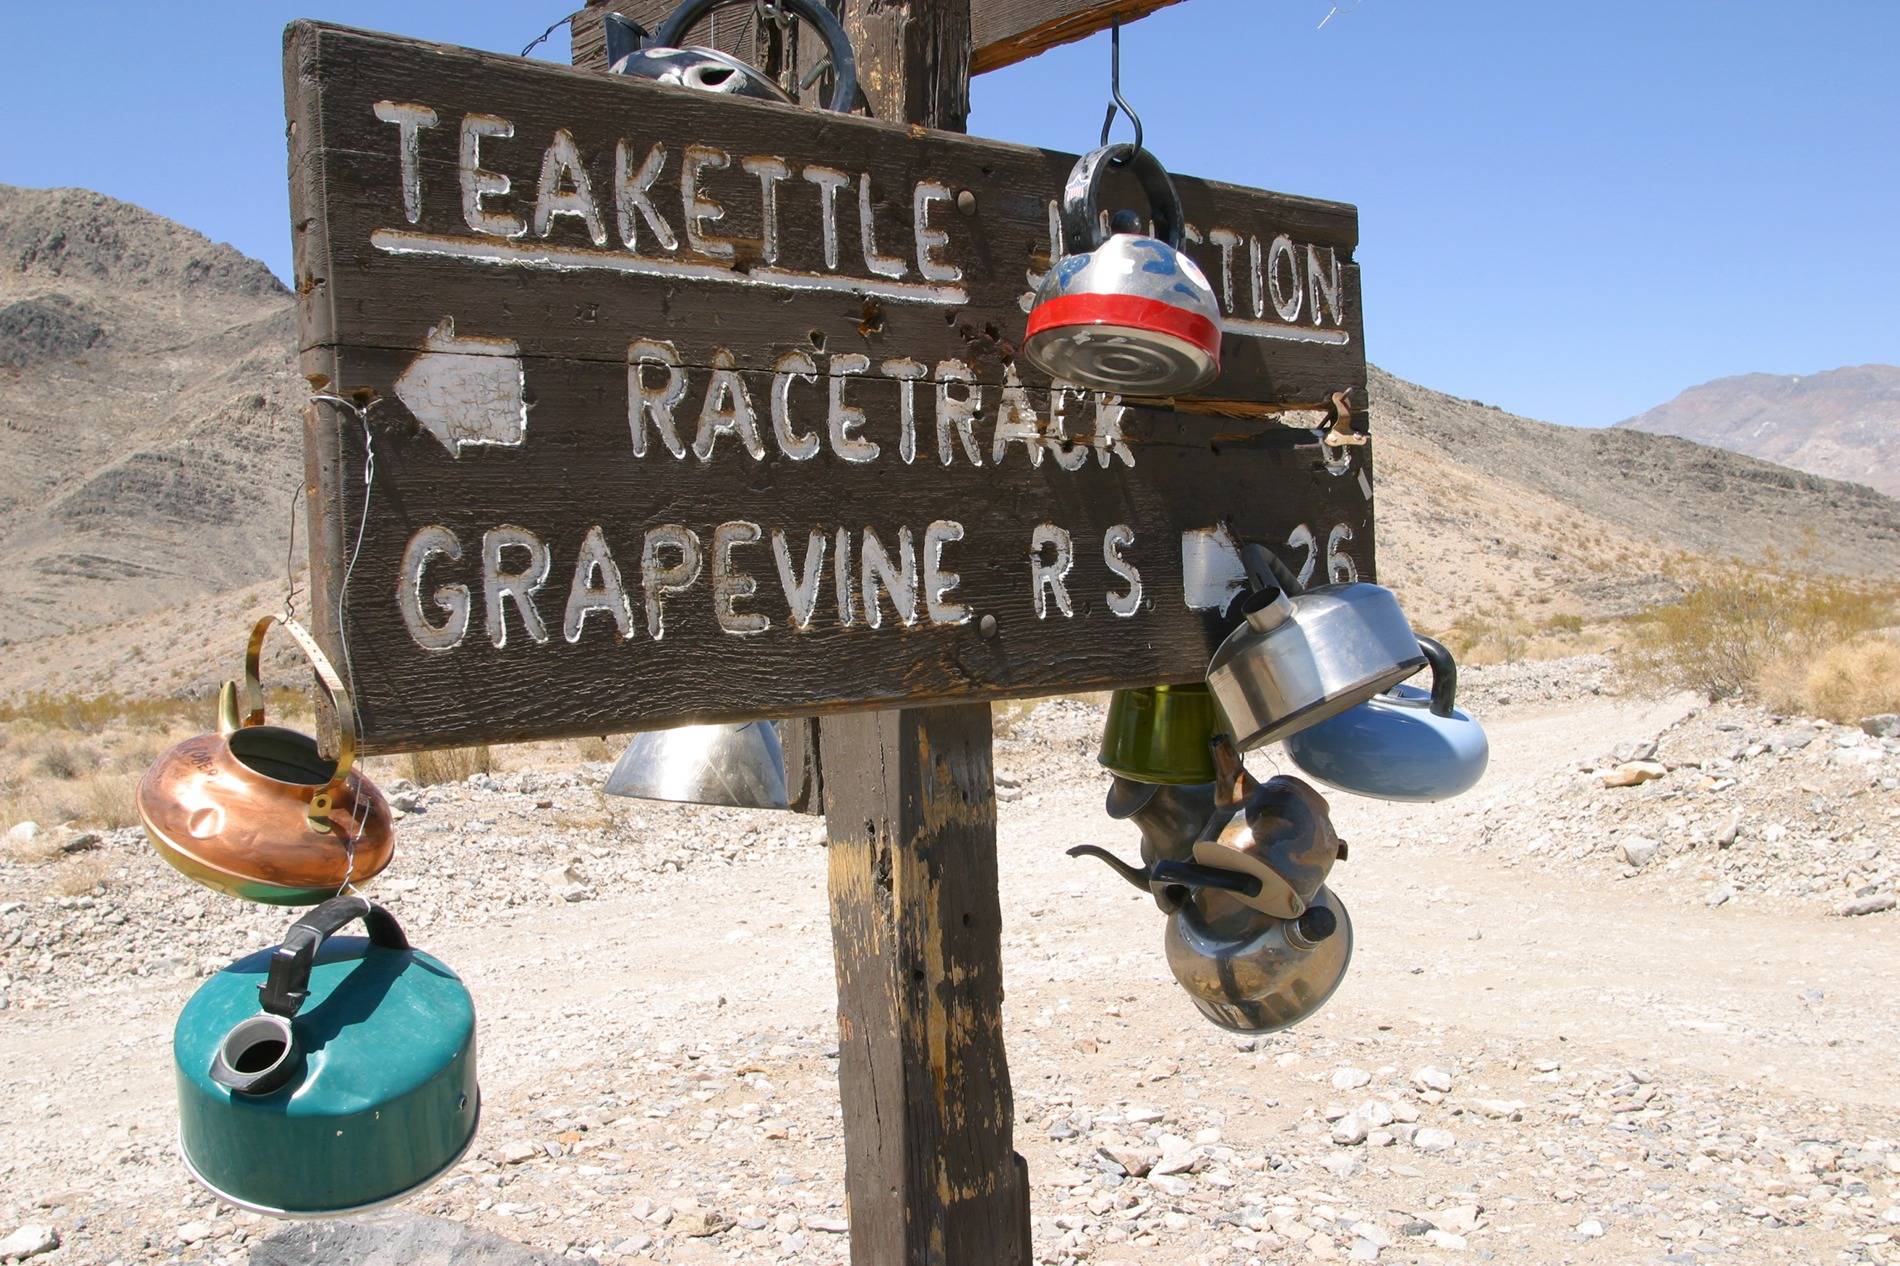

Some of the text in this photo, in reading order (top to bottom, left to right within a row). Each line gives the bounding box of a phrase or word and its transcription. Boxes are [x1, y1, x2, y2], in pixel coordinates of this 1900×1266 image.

[373, 99, 1344, 327] TEAKETTLE JTION
[627, 337, 1136, 472] RACETRACK
[399, 519, 974, 651] GRAPEVINE
